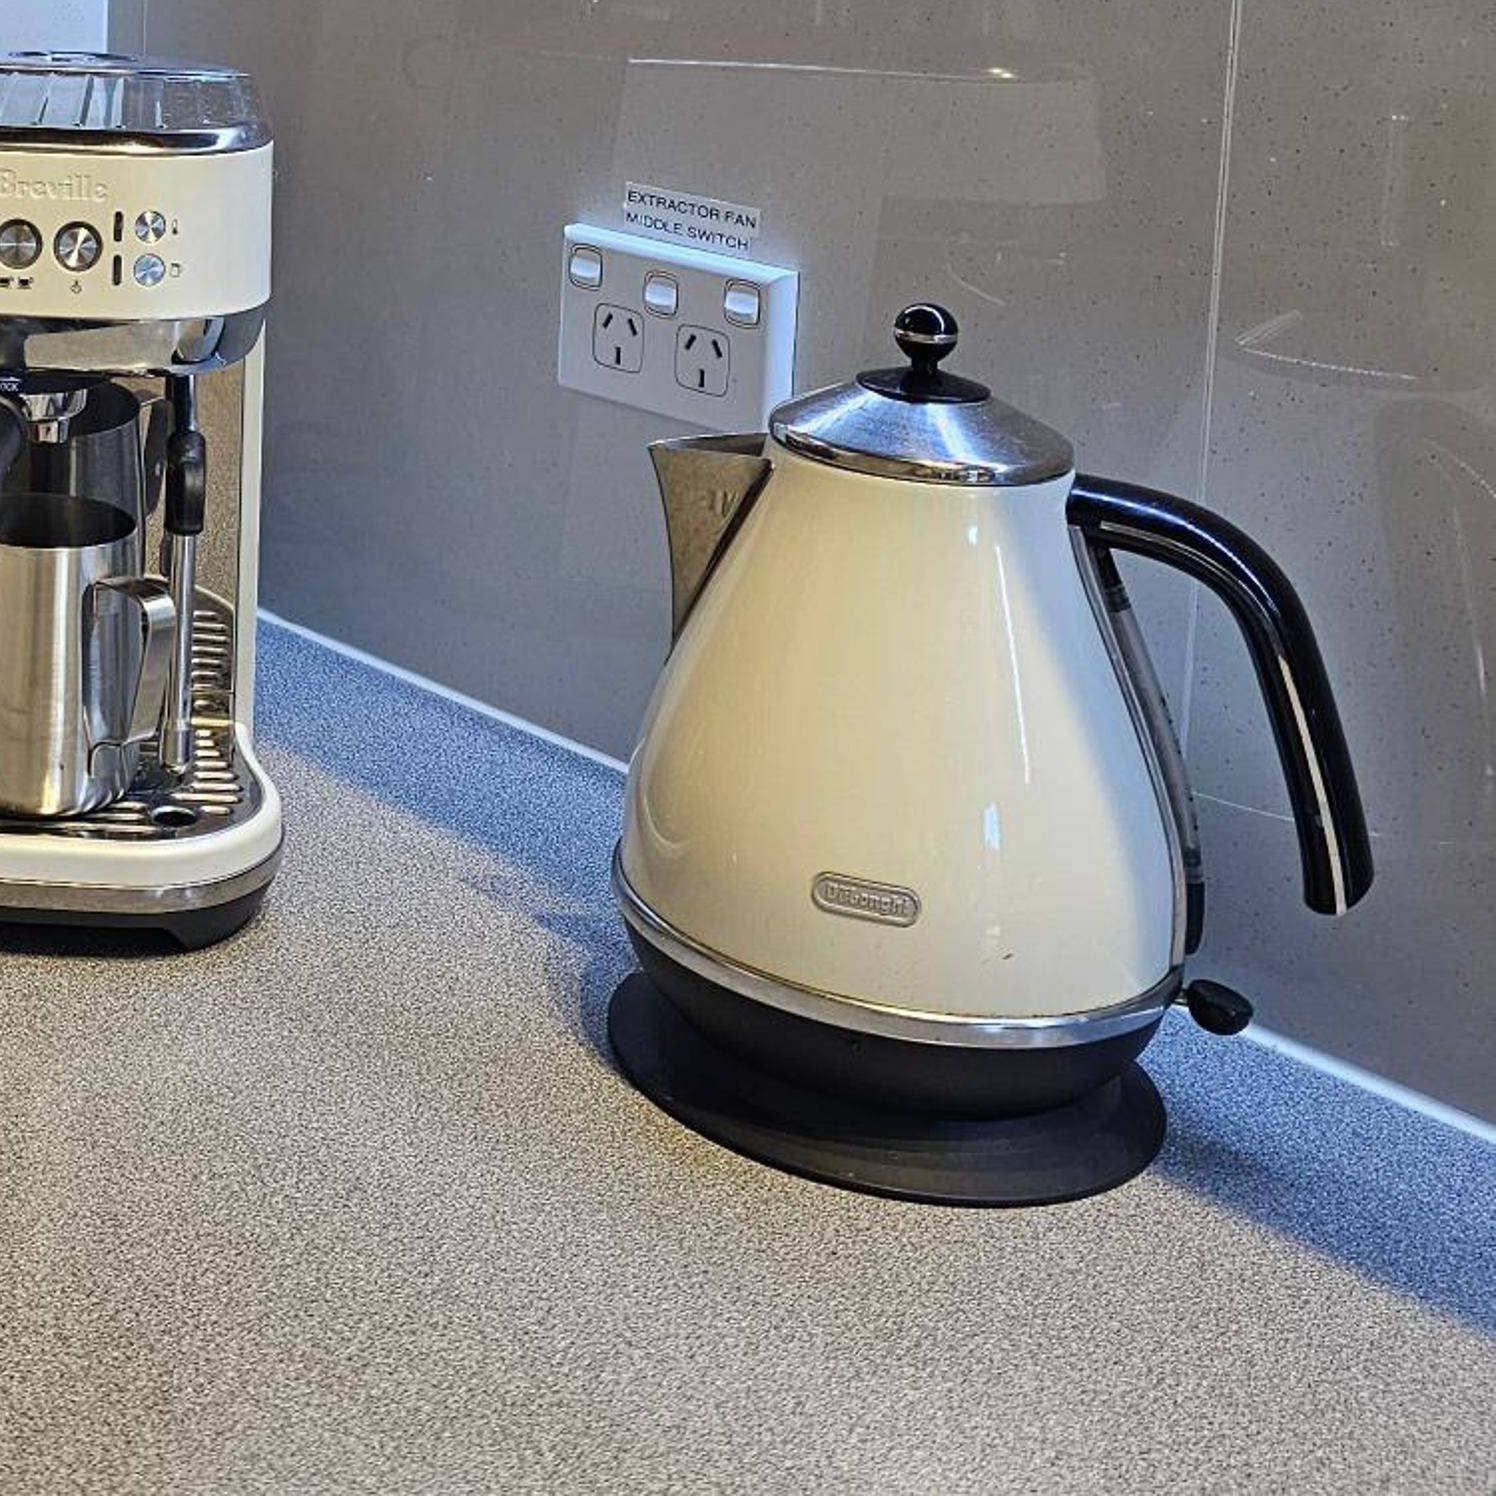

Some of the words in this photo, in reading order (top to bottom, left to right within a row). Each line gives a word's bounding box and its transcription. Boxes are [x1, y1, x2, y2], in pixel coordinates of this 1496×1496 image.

[627, 190, 721, 221] EXTRACTOR
[724, 210, 757, 229] FAN
[625, 211, 683, 237] MIDDLE
[687, 225, 749, 251] SWITCH
